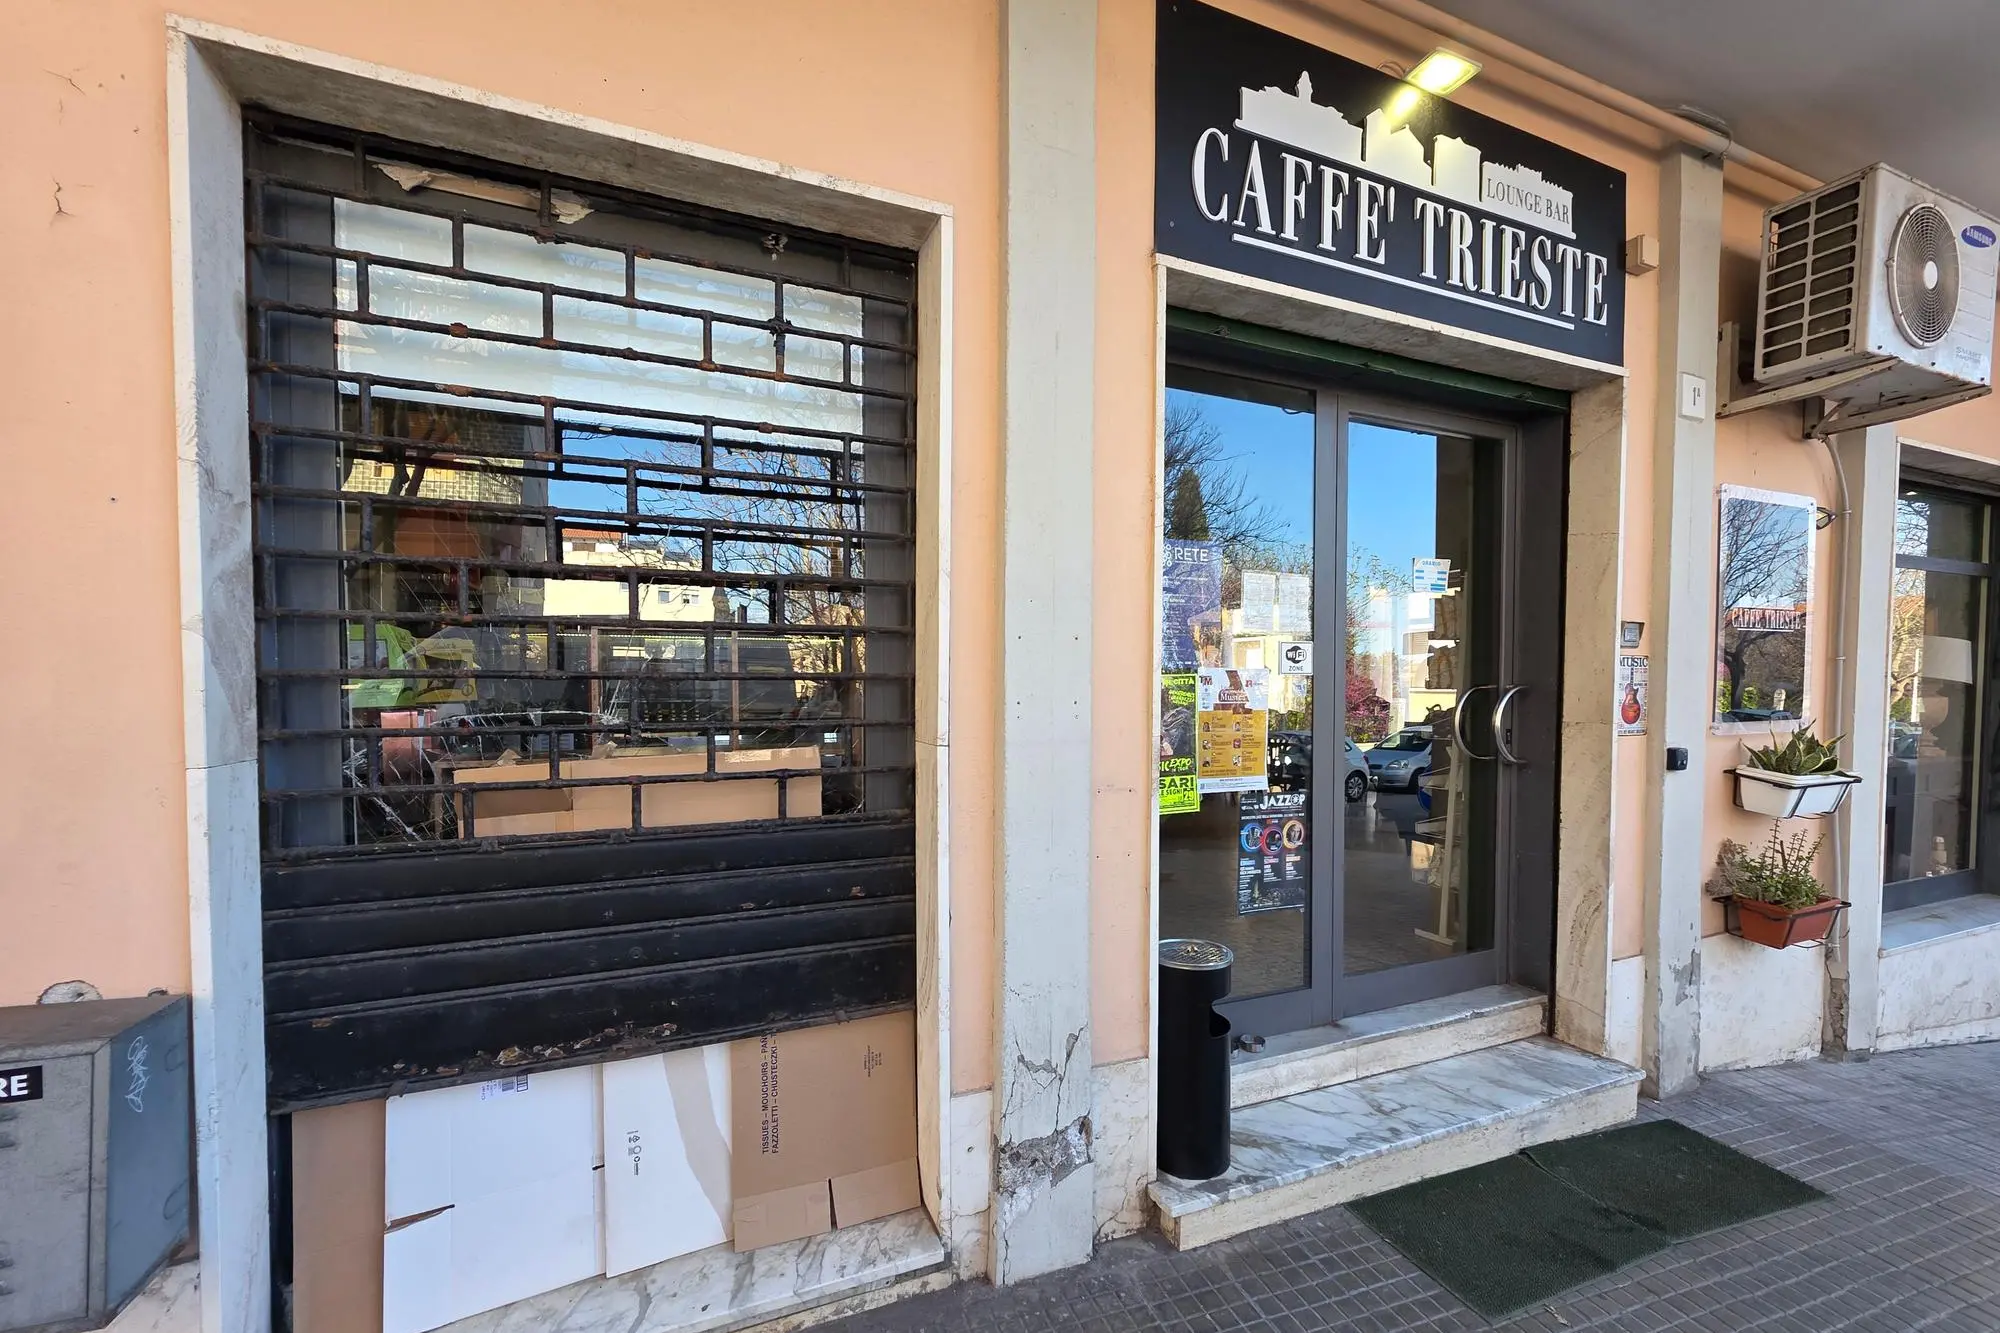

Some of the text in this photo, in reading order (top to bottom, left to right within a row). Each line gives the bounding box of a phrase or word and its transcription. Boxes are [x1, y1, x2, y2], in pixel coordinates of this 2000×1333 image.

[1486, 177, 1571, 225] LOUNGE BAR
[1191, 127, 1608, 326] CAFFE' TRIESTE
[1966, 226, 1993, 247] SAMSUNG
[1174, 547, 1209, 562] RETE
[1764, 609, 1801, 629] TRIESTE
[1183, 790, 1194, 800] 29
[761, 1061, 769, 1111] MOUCHOIRS
[770, 1046, 778, 1097] CHUSTECZKI
[771, 1106, 779, 1153] FAZZOLETTI
